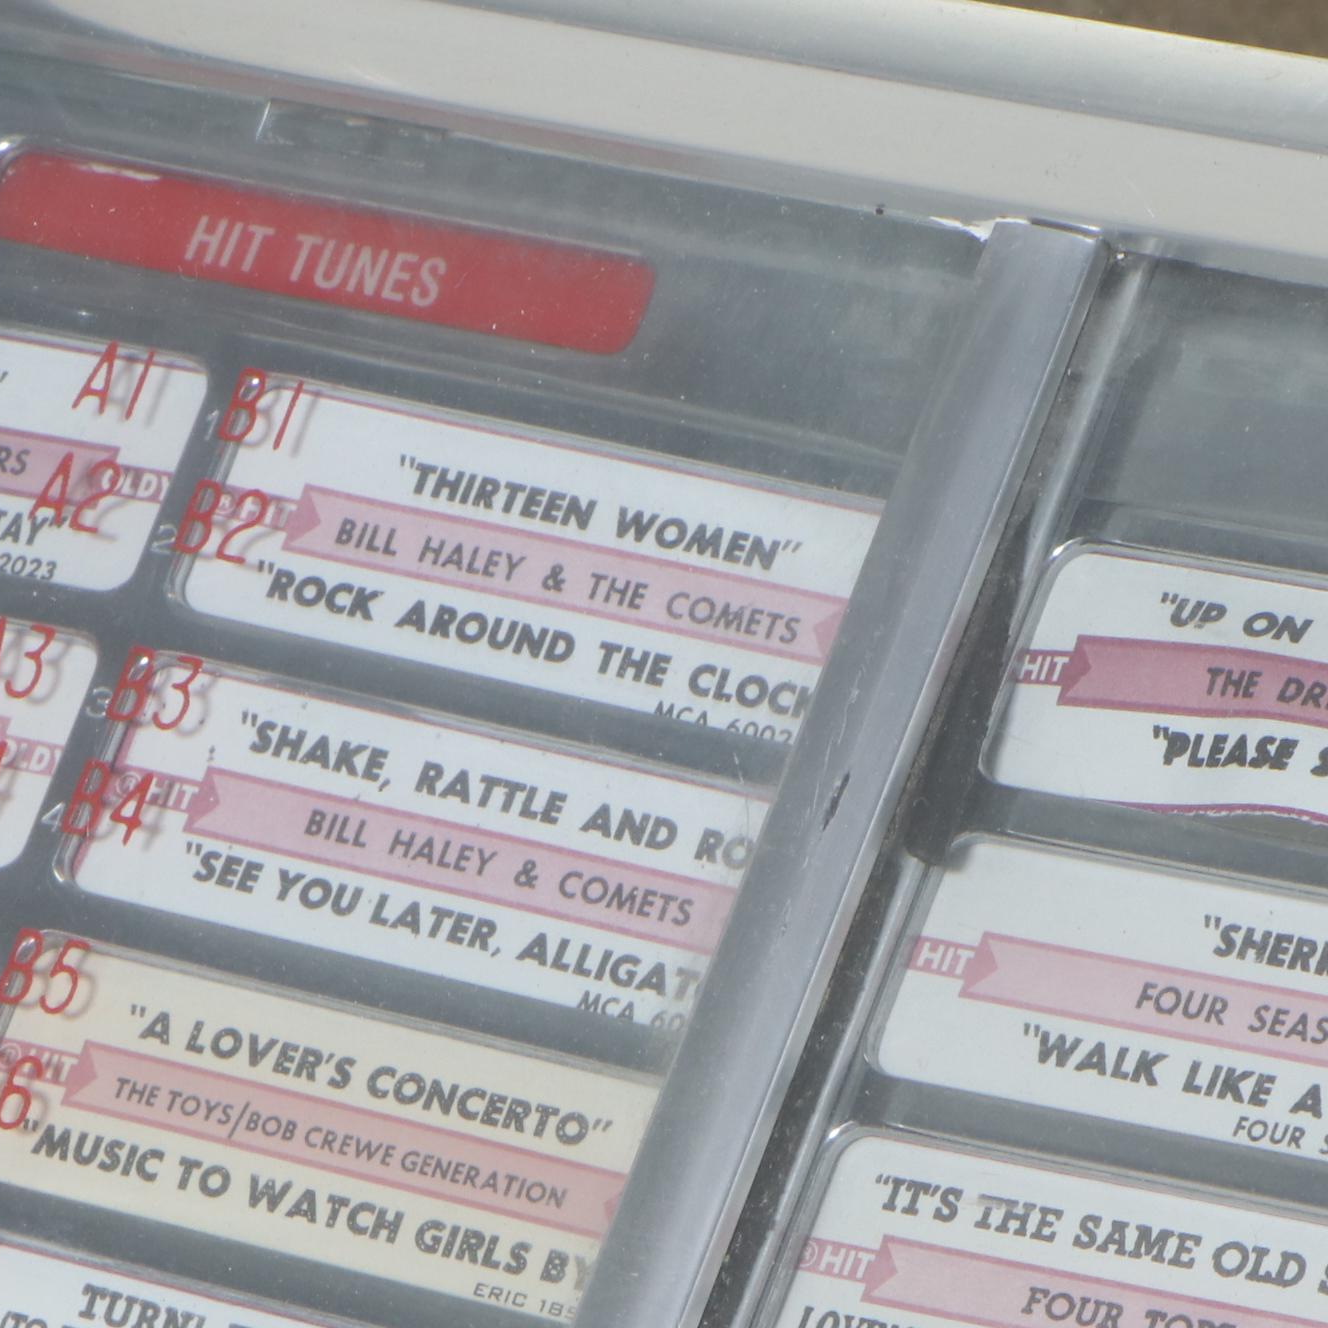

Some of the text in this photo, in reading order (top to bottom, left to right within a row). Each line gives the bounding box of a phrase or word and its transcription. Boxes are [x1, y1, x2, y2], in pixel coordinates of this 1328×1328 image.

[185, 214, 448, 309] HIT TUNES
[400, 454, 801, 570] "THIRTEEN WOMEN"
[335, 517, 800, 644] BILL HALEY & THE COMETS
[1206, 666, 1263, 698] THE
[1153, 724, 1299, 770] "PLEASE
[304, 808, 693, 926] BILL HALEY & COMETS
[1135, 982, 1228, 1025] FOUR
[130, 1004, 612, 1145] "A LOVER'S CONCERTO"
[115, 1077, 567, 1208] THE TOYS/BOB CREWE GENERATION
[1233, 1116, 1305, 1149] FOUR
